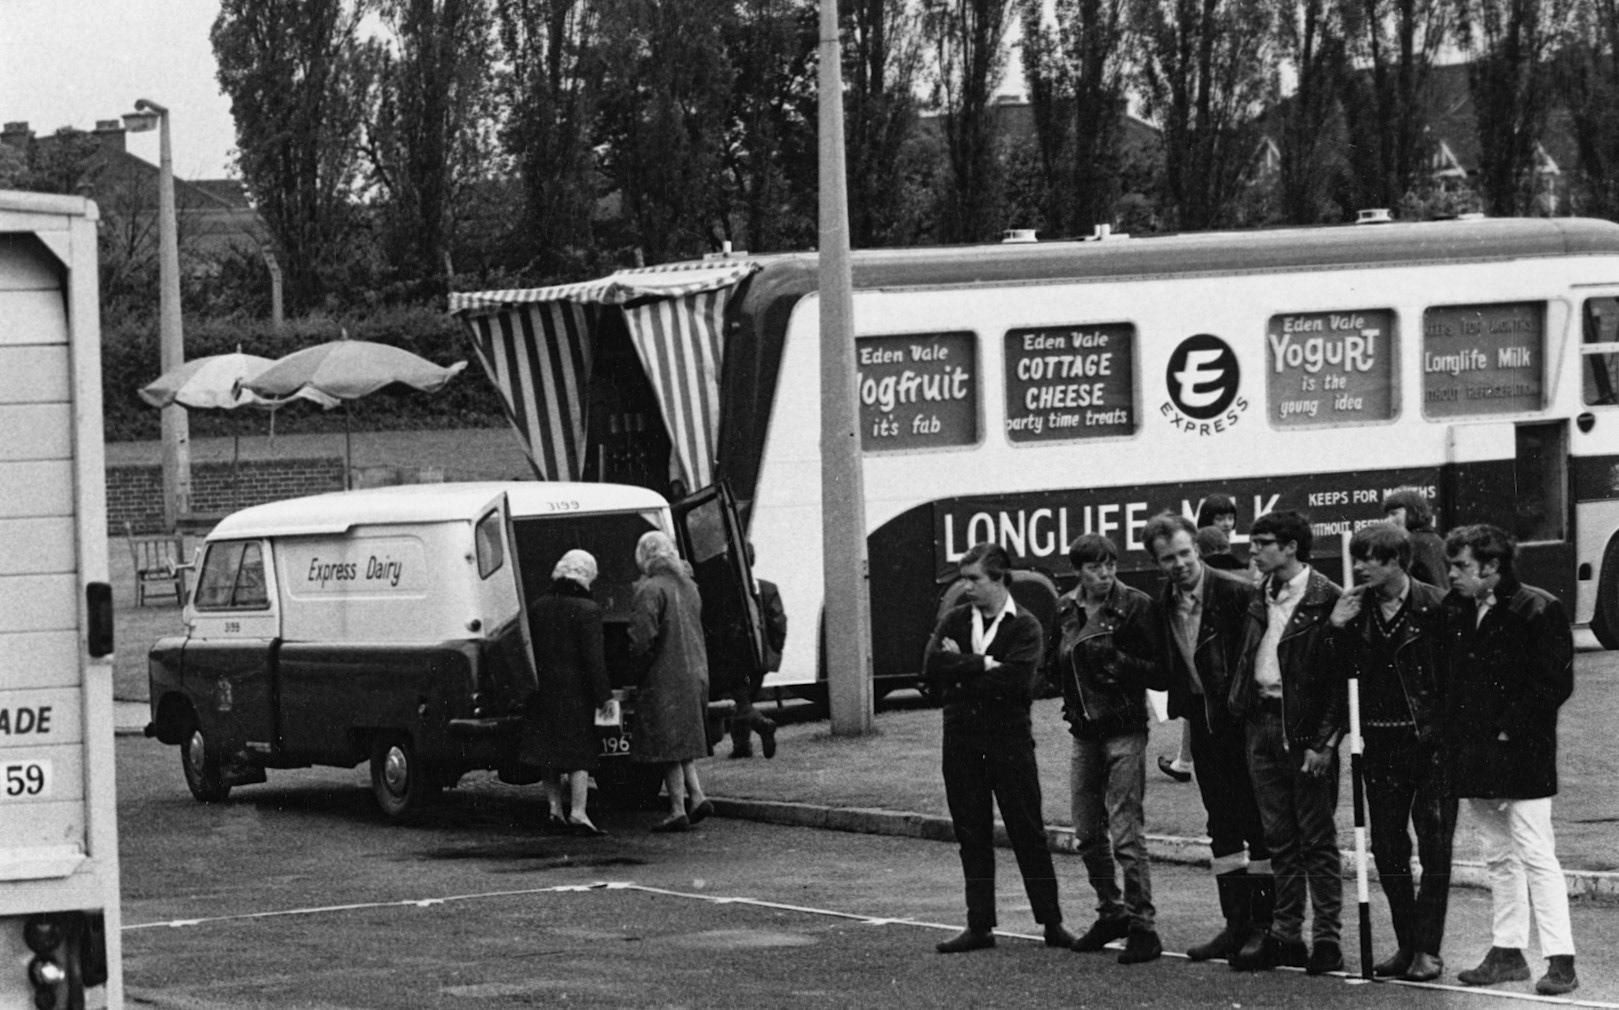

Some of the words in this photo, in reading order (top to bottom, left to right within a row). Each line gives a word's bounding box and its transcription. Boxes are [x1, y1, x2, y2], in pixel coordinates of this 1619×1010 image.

[1283, 316, 1322, 333] Eden
[1330, 314, 1364, 330] Vale
[1023, 334, 1065, 350] Eden
[1071, 331, 1108, 348] Vale
[860, 347, 903, 364] Eden
[910, 344, 948, 361] Vale
[1017, 352, 1112, 381] COTTAGE
[1425, 348, 1487, 375] Longlife
[1498, 346, 1531, 368] Milk
[857, 365, 969, 412] ogfruit
[1302, 375, 1316, 391] is
[1324, 374, 1346, 390] the
[1025, 383, 1105, 410] CHEESE
[1280, 398, 1319, 419] young
[1334, 393, 1363, 411] idea
[873, 414, 898, 437] it's
[912, 414, 941, 434] fab
[1048, 412, 1080, 428] time
[1085, 408, 1127, 426] treats
[1160, 396, 1248, 436] EXPRESS
[1308, 491, 1349, 507] KEEPS
[1353, 489, 1378, 503] FOR
[944, 502, 1148, 562] LONGLIFE
[308, 557, 357, 589] Express
[366, 555, 402, 587] Dairy
[6, 764, 45, 796] 59
